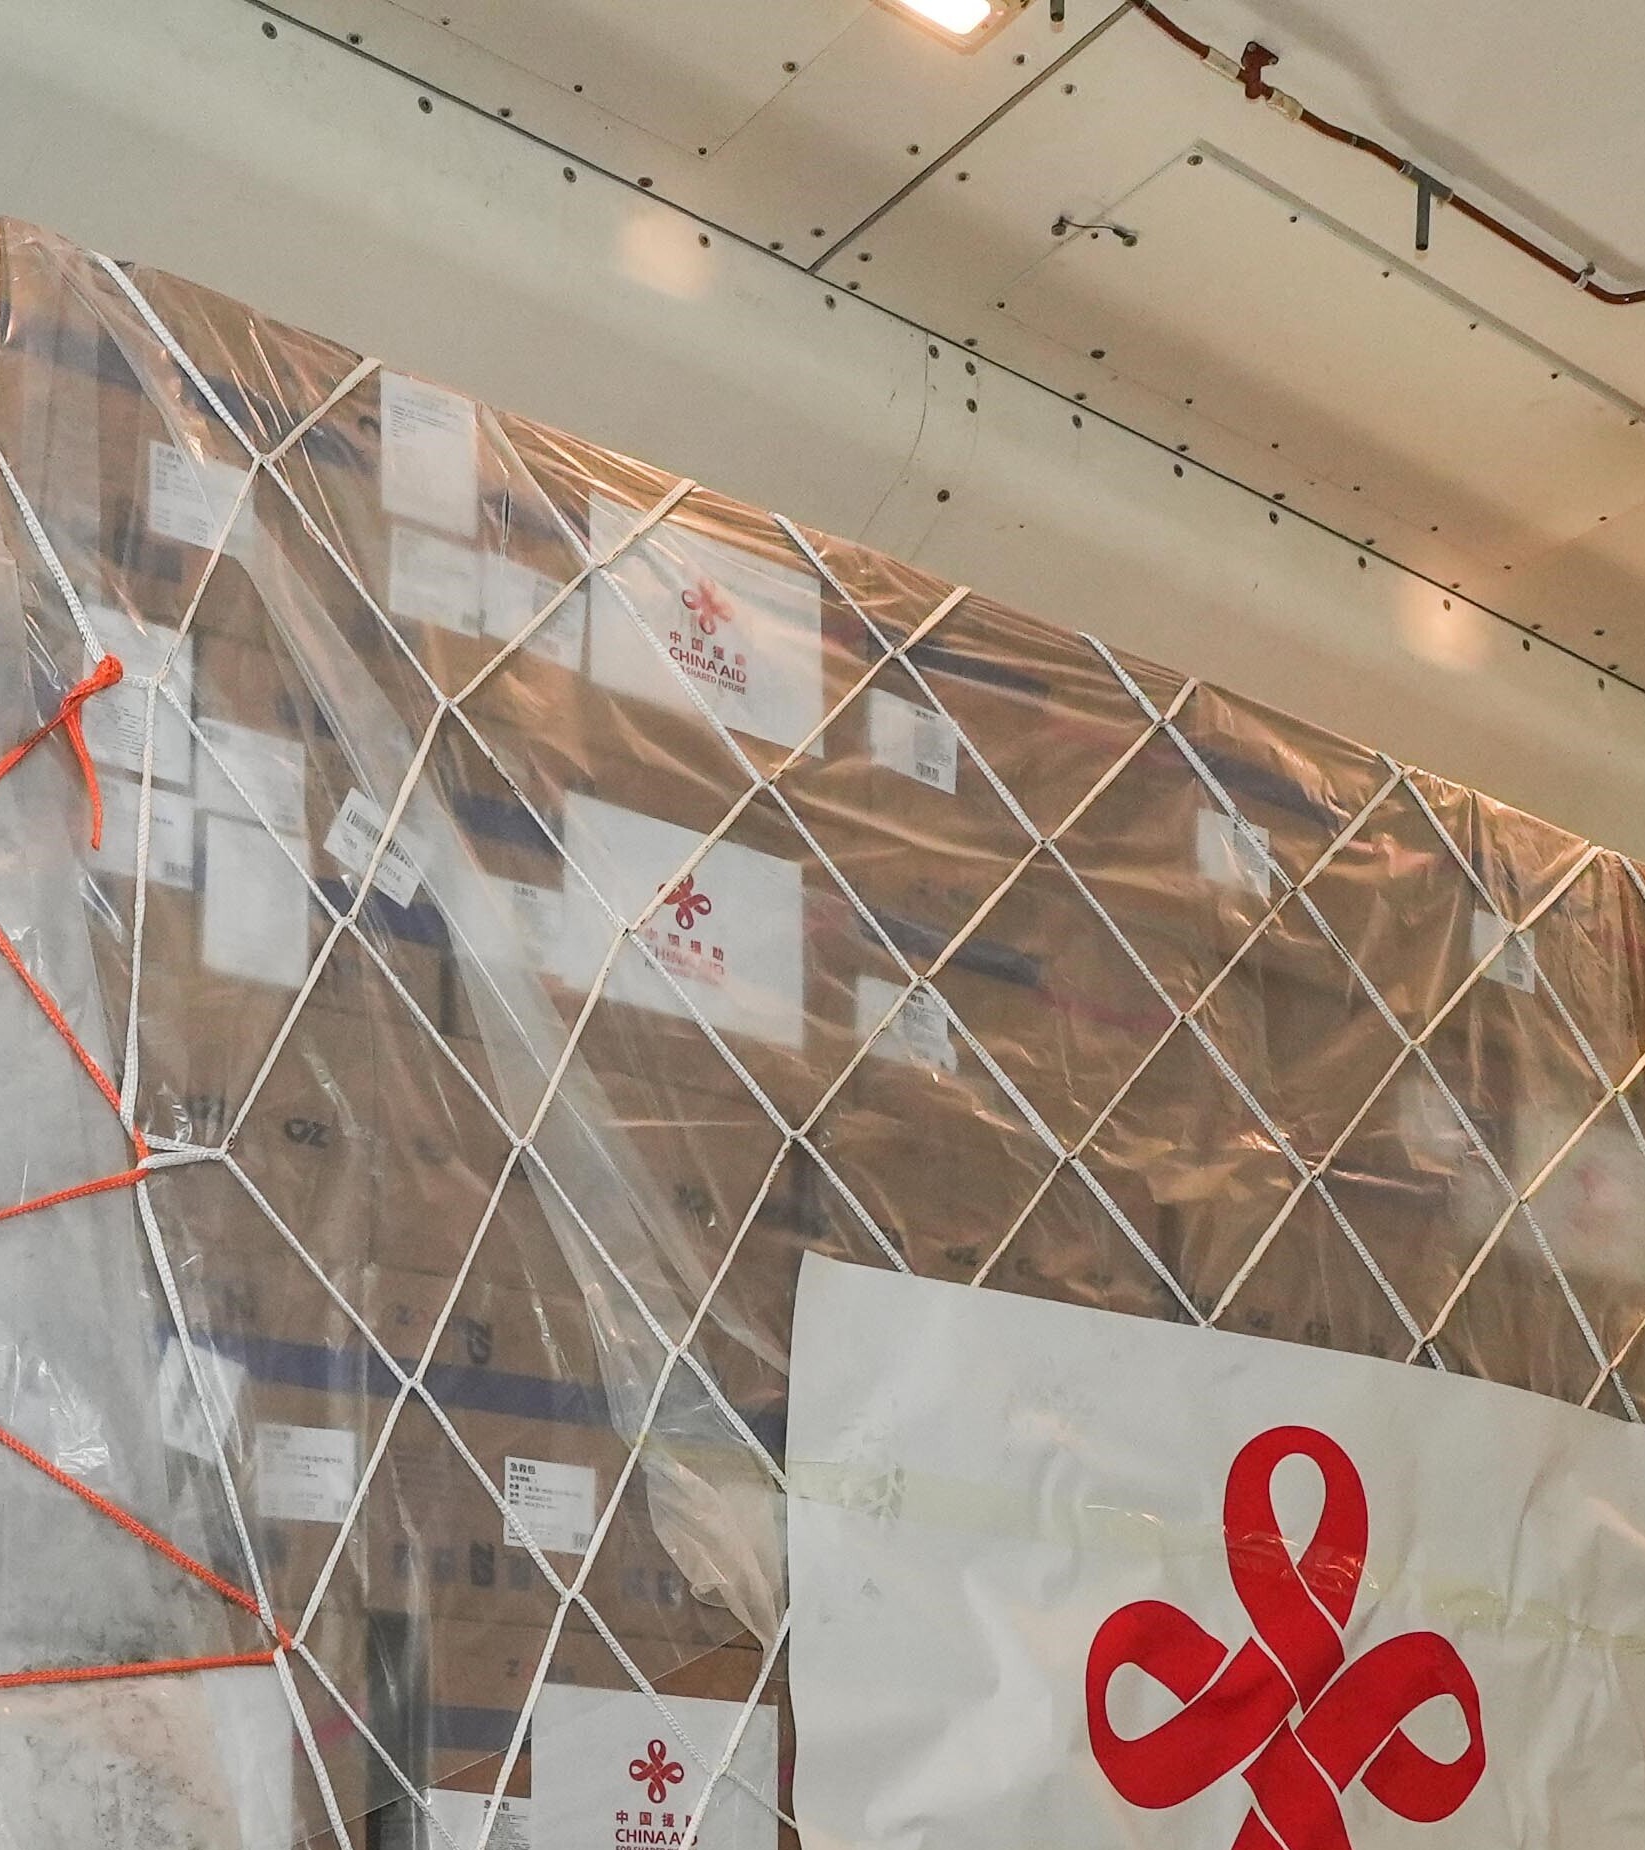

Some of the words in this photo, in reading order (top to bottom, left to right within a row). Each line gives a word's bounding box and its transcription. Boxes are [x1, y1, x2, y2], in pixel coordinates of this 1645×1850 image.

[669, 647, 717, 674] CHINA
[720, 665, 747, 684] AID
[616, 1829, 667, 1845] CHINA
